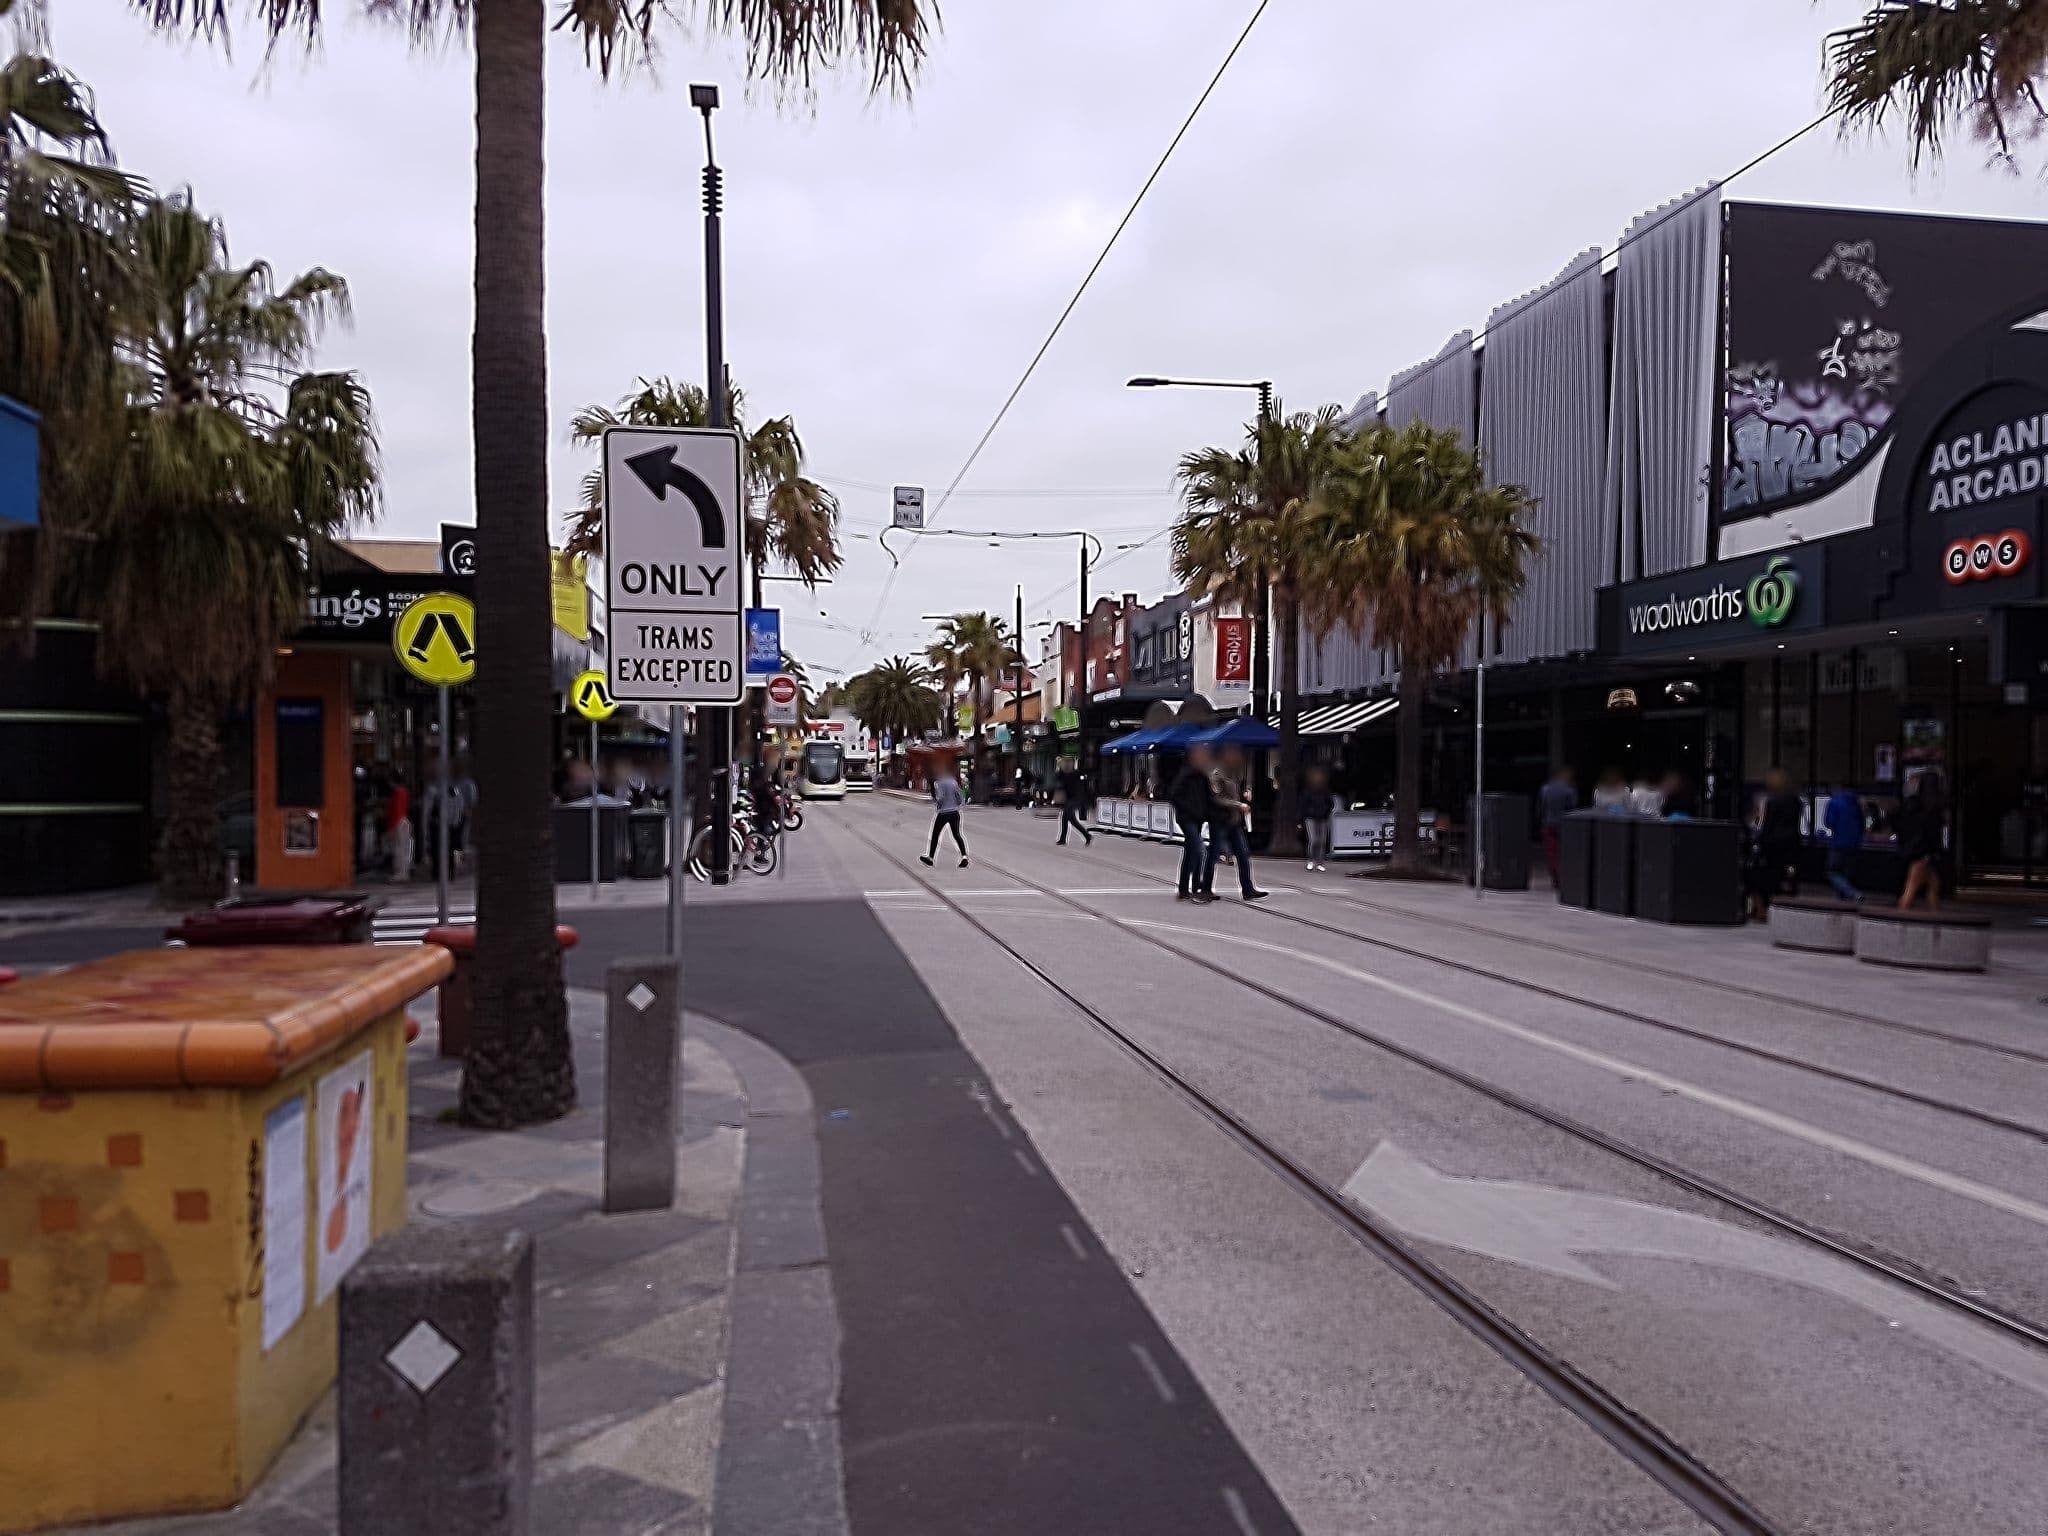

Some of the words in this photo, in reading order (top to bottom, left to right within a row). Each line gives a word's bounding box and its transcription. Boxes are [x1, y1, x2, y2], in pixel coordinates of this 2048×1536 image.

[1930, 413, 2048, 475] ACLAN
[1929, 454, 2048, 513] ARCAD
[1953, 544, 2013, 569] BWS
[621, 563, 727, 596] ONLY
[309, 588, 382, 627] ings
[1629, 583, 1744, 634] woolworths
[637, 625, 713, 650] TRAMS
[618, 658, 732, 683] EXCEPTED
